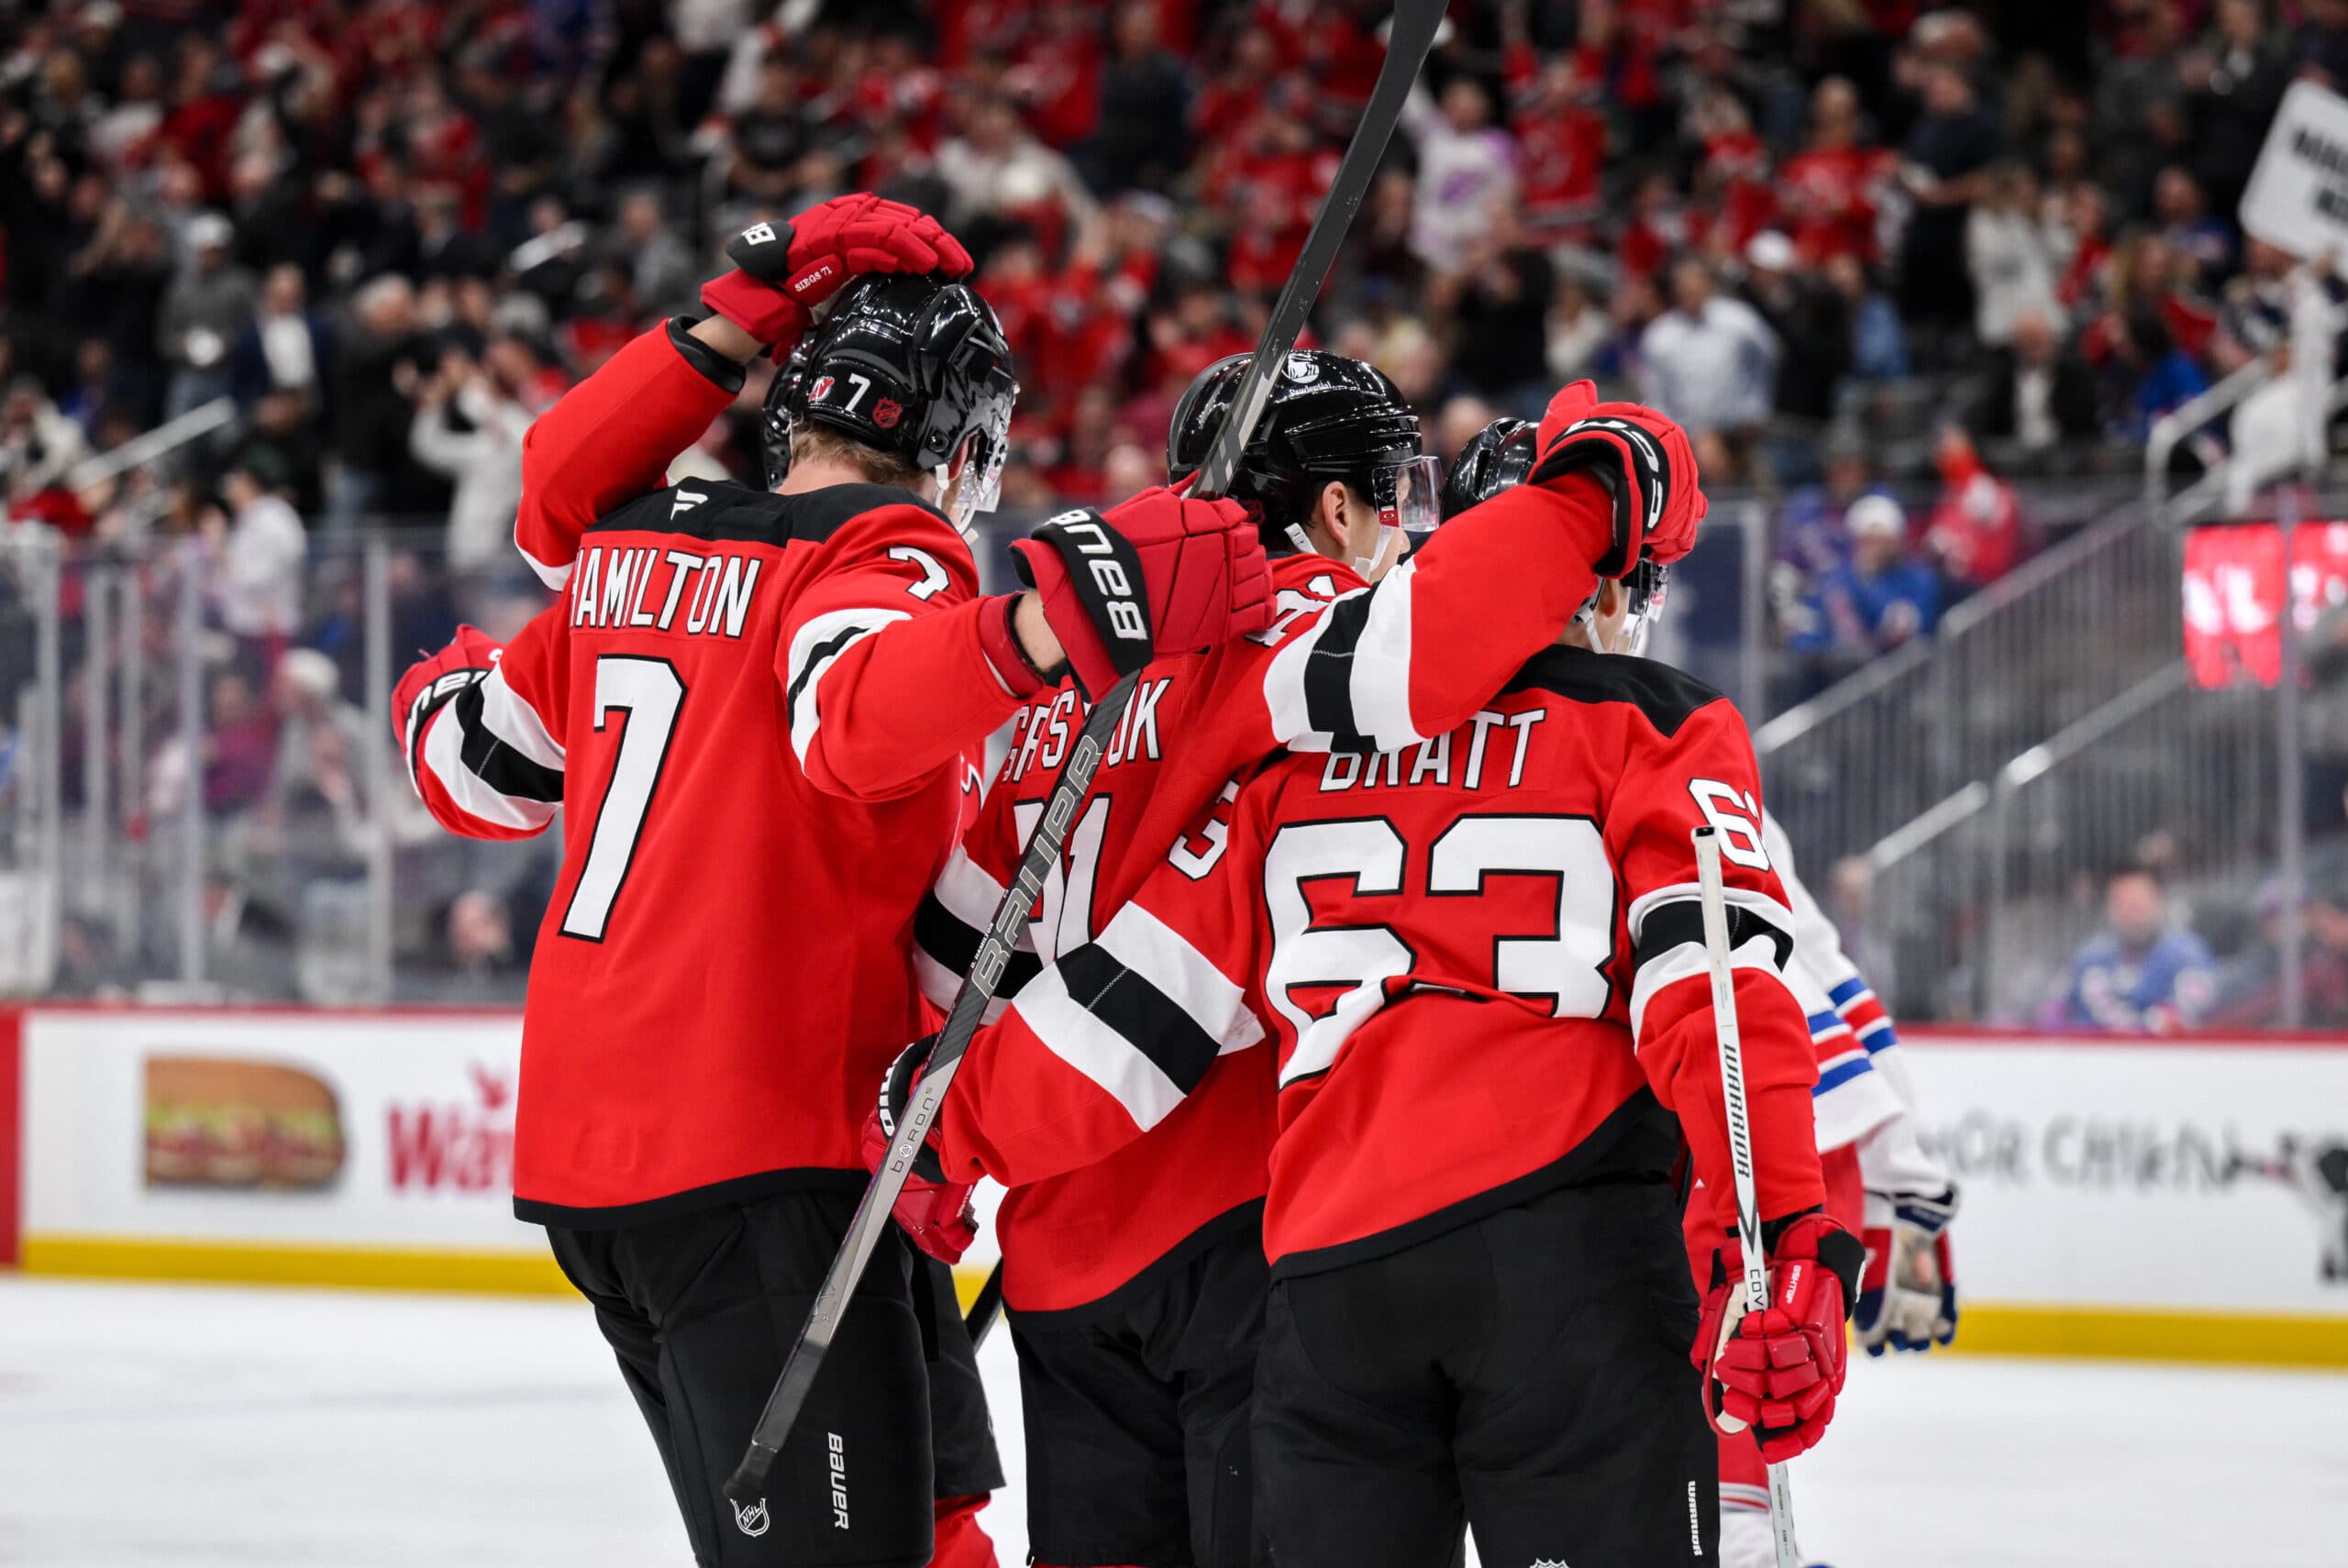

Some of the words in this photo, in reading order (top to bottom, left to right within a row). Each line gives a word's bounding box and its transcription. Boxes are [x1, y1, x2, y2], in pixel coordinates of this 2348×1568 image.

[844, 372, 871, 412] 7
[1288, 381, 1333, 397] Prudential
[558, 654, 688, 944] 7
[1264, 813, 1620, 1091] 63
[1724, 1043, 1750, 1178] WARRIOR
[1749, 1268, 1765, 1311] COV
[828, 1431, 849, 1529] BAUER
[1688, 1480, 1703, 1556] WARRIOR
